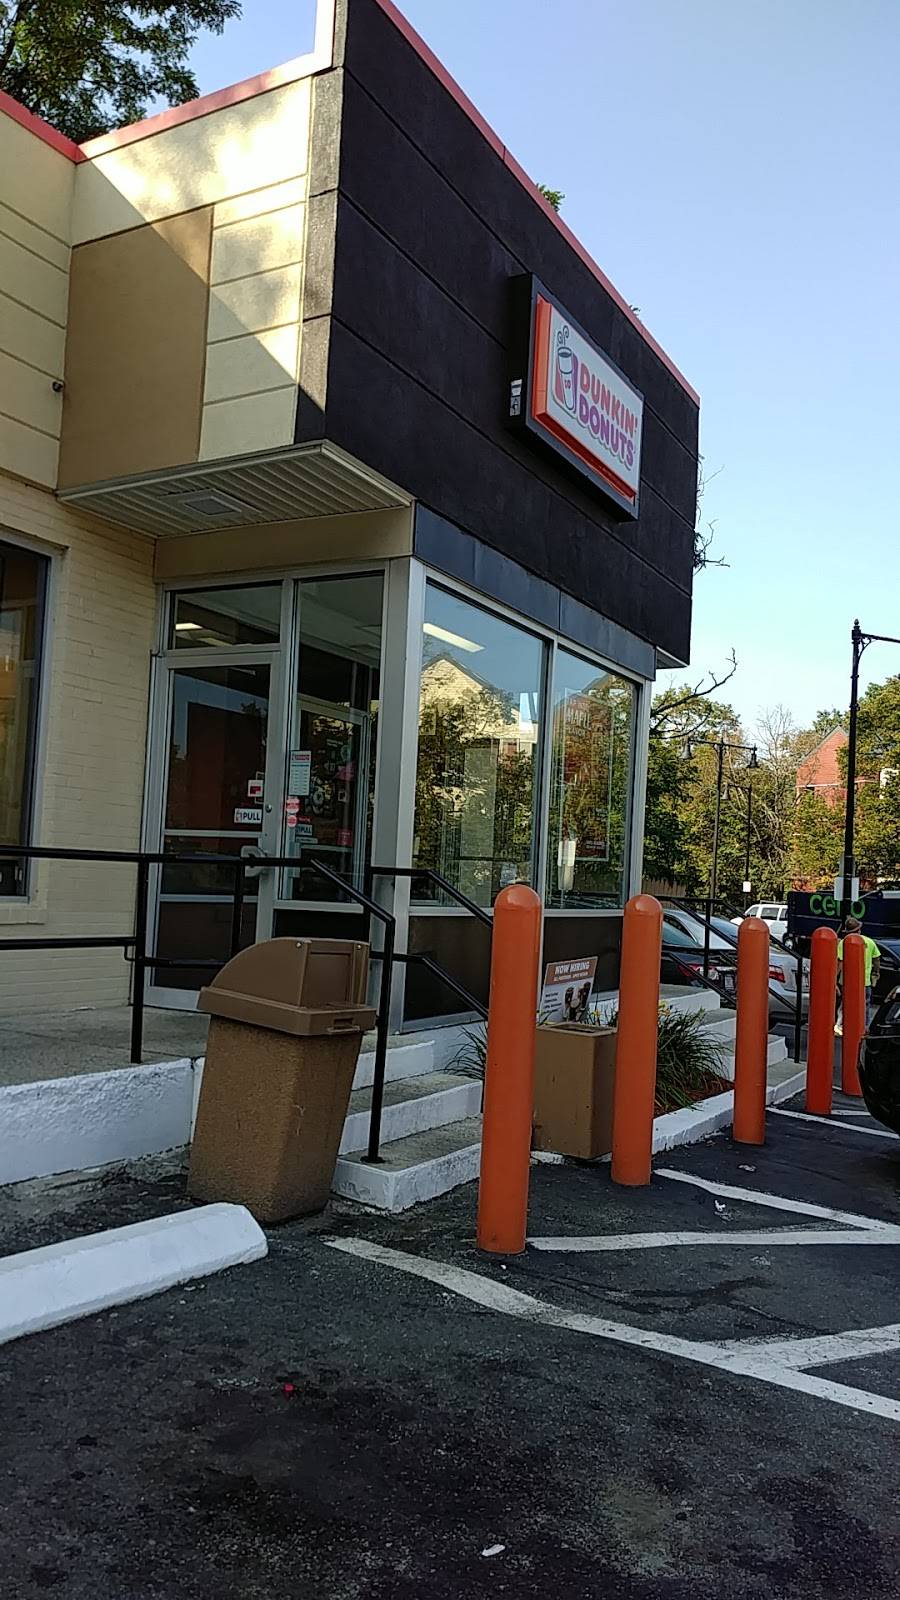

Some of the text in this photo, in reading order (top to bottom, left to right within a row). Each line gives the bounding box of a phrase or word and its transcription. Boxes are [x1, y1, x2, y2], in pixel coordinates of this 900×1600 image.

[580, 363, 637, 438] DUNKIN'
[579, 394, 634, 466] DONUTS
[243, 811, 260, 821] PULL
[555, 961, 590, 975] NOW HIRING
